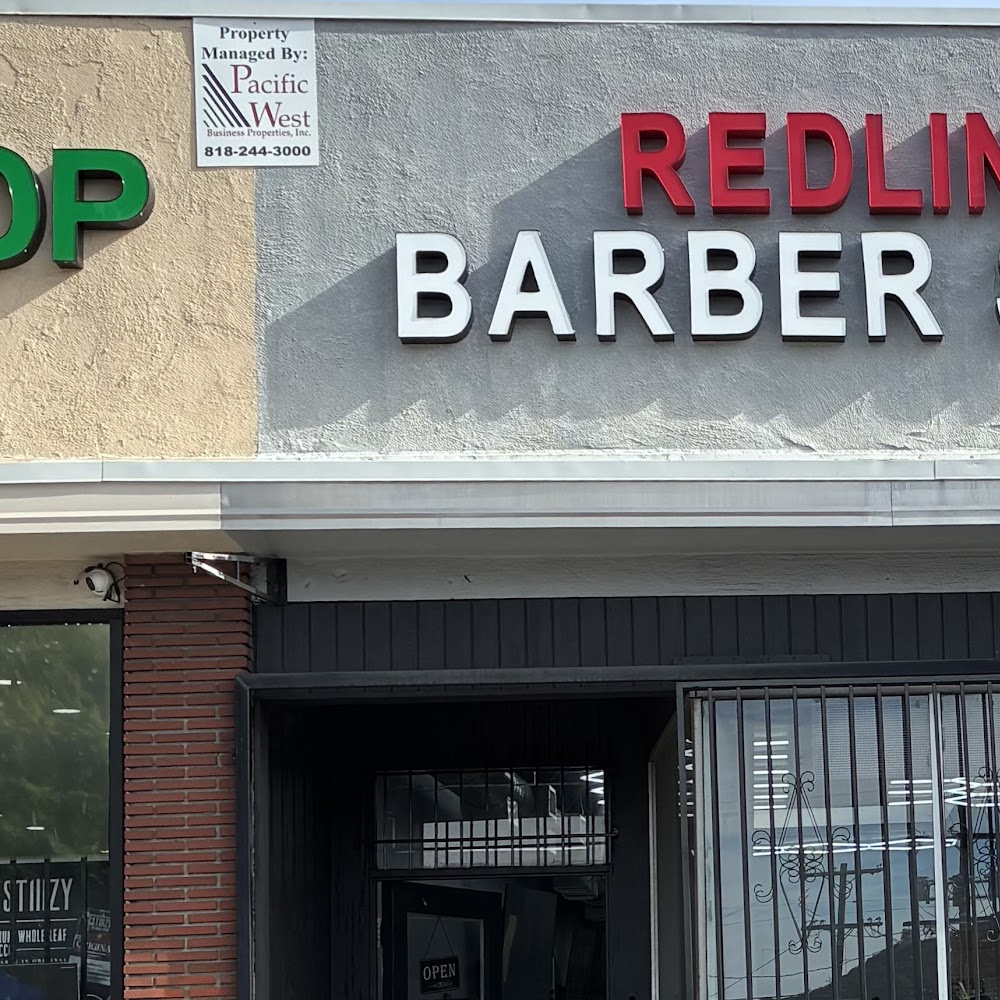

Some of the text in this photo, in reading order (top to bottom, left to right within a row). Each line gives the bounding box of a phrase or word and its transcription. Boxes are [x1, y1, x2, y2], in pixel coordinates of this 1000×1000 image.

[220, 26, 289, 42] Property
[201, 47, 308, 63] Managed By:
[230, 64, 309, 94] Pacific
[248, 102, 311, 128] West
[207, 129, 311, 139] Business Properties, Inc.
[204, 145, 311, 157] 818-244-3000
[395, 230, 944, 344] BARBER
[18, 929, 45, 943] WHOLE
[49, 928, 67, 942] LEAF
[423, 963, 456, 980] OPEN
